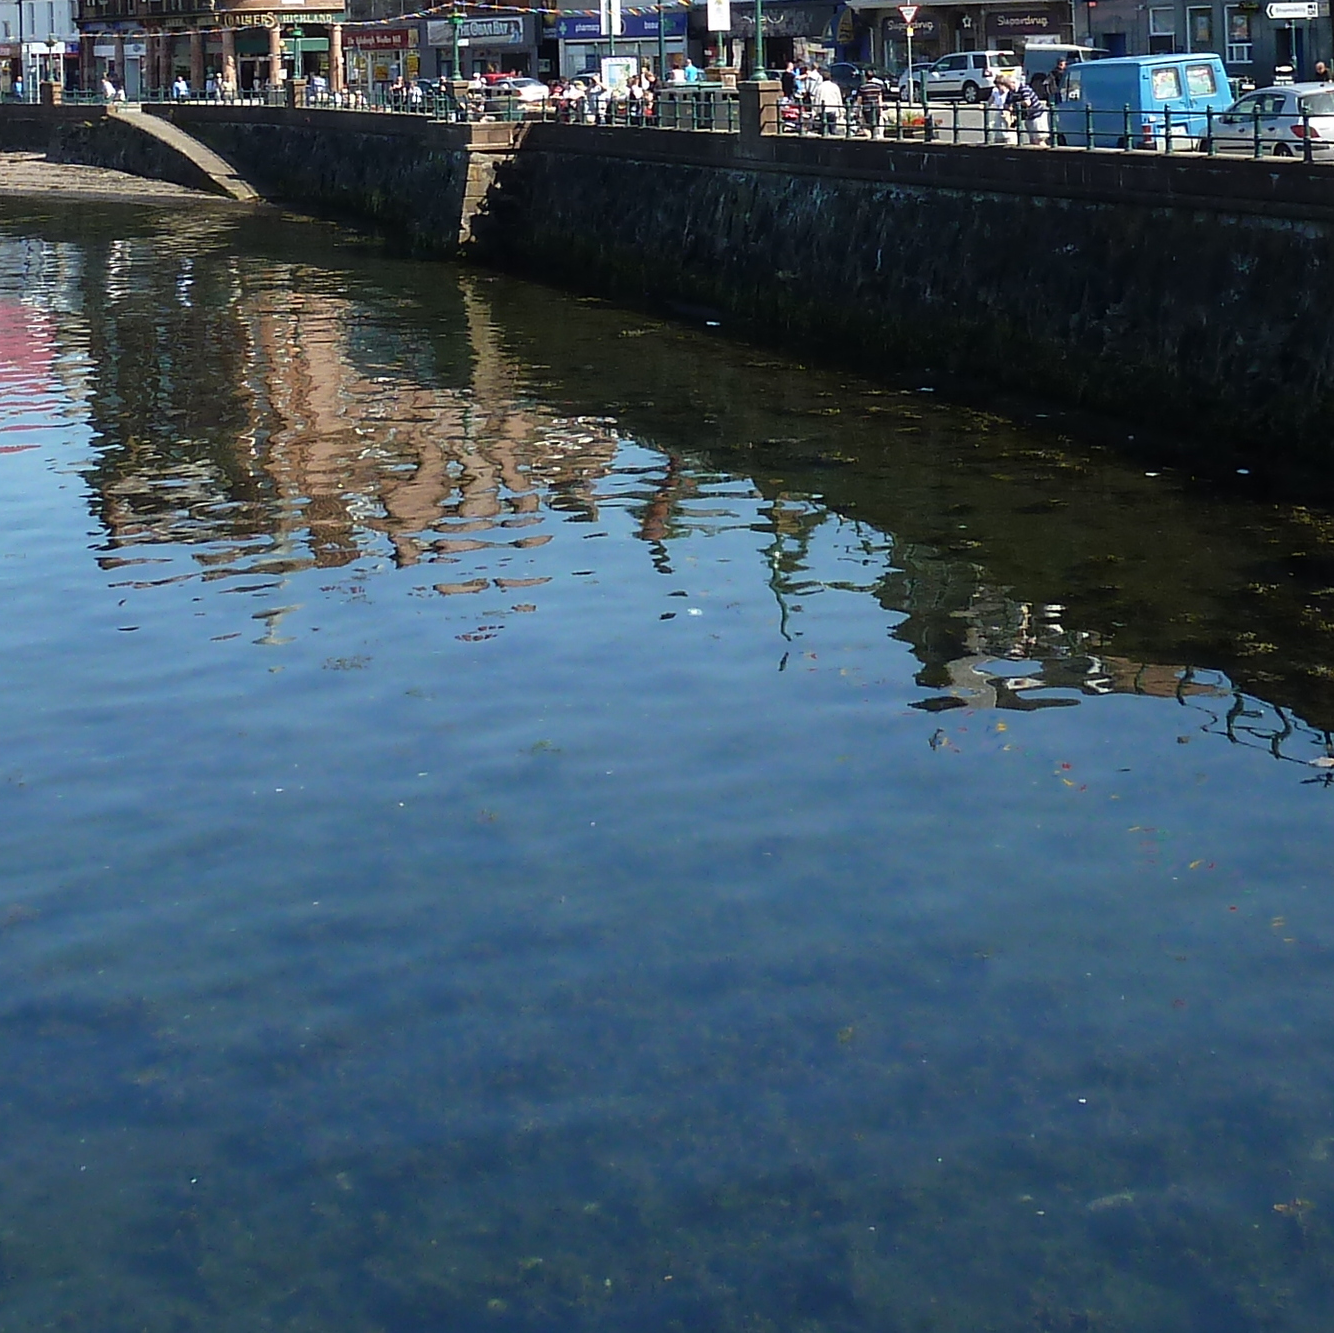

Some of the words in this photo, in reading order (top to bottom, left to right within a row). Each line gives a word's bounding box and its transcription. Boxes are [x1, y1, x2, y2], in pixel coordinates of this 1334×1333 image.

[282, 14, 333, 24] HIGHLAND
[997, 15, 1049, 27] Superdrug
[575, 23, 600, 33] pharmacy
[644, 21, 659, 30] beau
